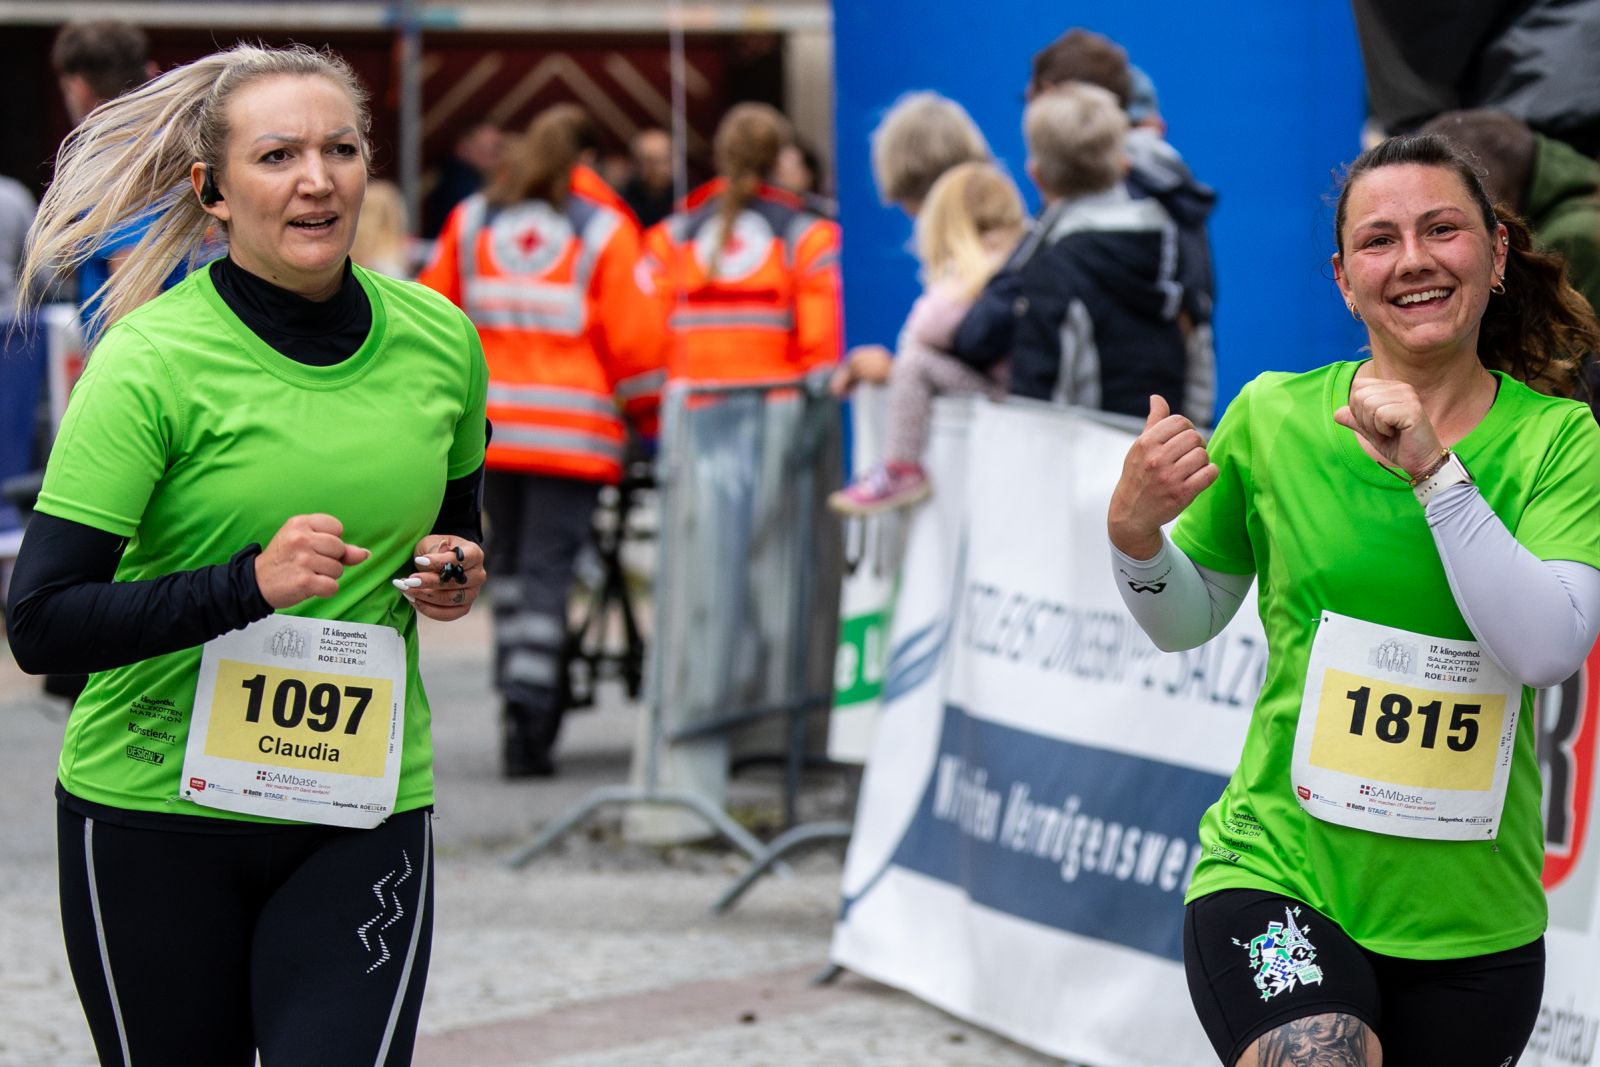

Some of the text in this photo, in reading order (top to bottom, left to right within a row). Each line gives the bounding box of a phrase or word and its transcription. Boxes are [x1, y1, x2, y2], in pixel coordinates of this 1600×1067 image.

[322, 627, 330, 636] 17.
[320, 638, 368, 648] SALZKOTTEN
[319, 645, 367, 655] MARATHON
[1430, 645, 1438, 654] 17.
[1427, 655, 1480, 666] SALZKOTTEN
[1426, 662, 1479, 673] MARATHON
[242, 674, 374, 736] 1097
[1346, 686, 1482, 752] 1815
[258, 735, 340, 763] Claudia
[267, 772, 318, 787] SAMbase
[1370, 786, 1423, 804] SAMbase
